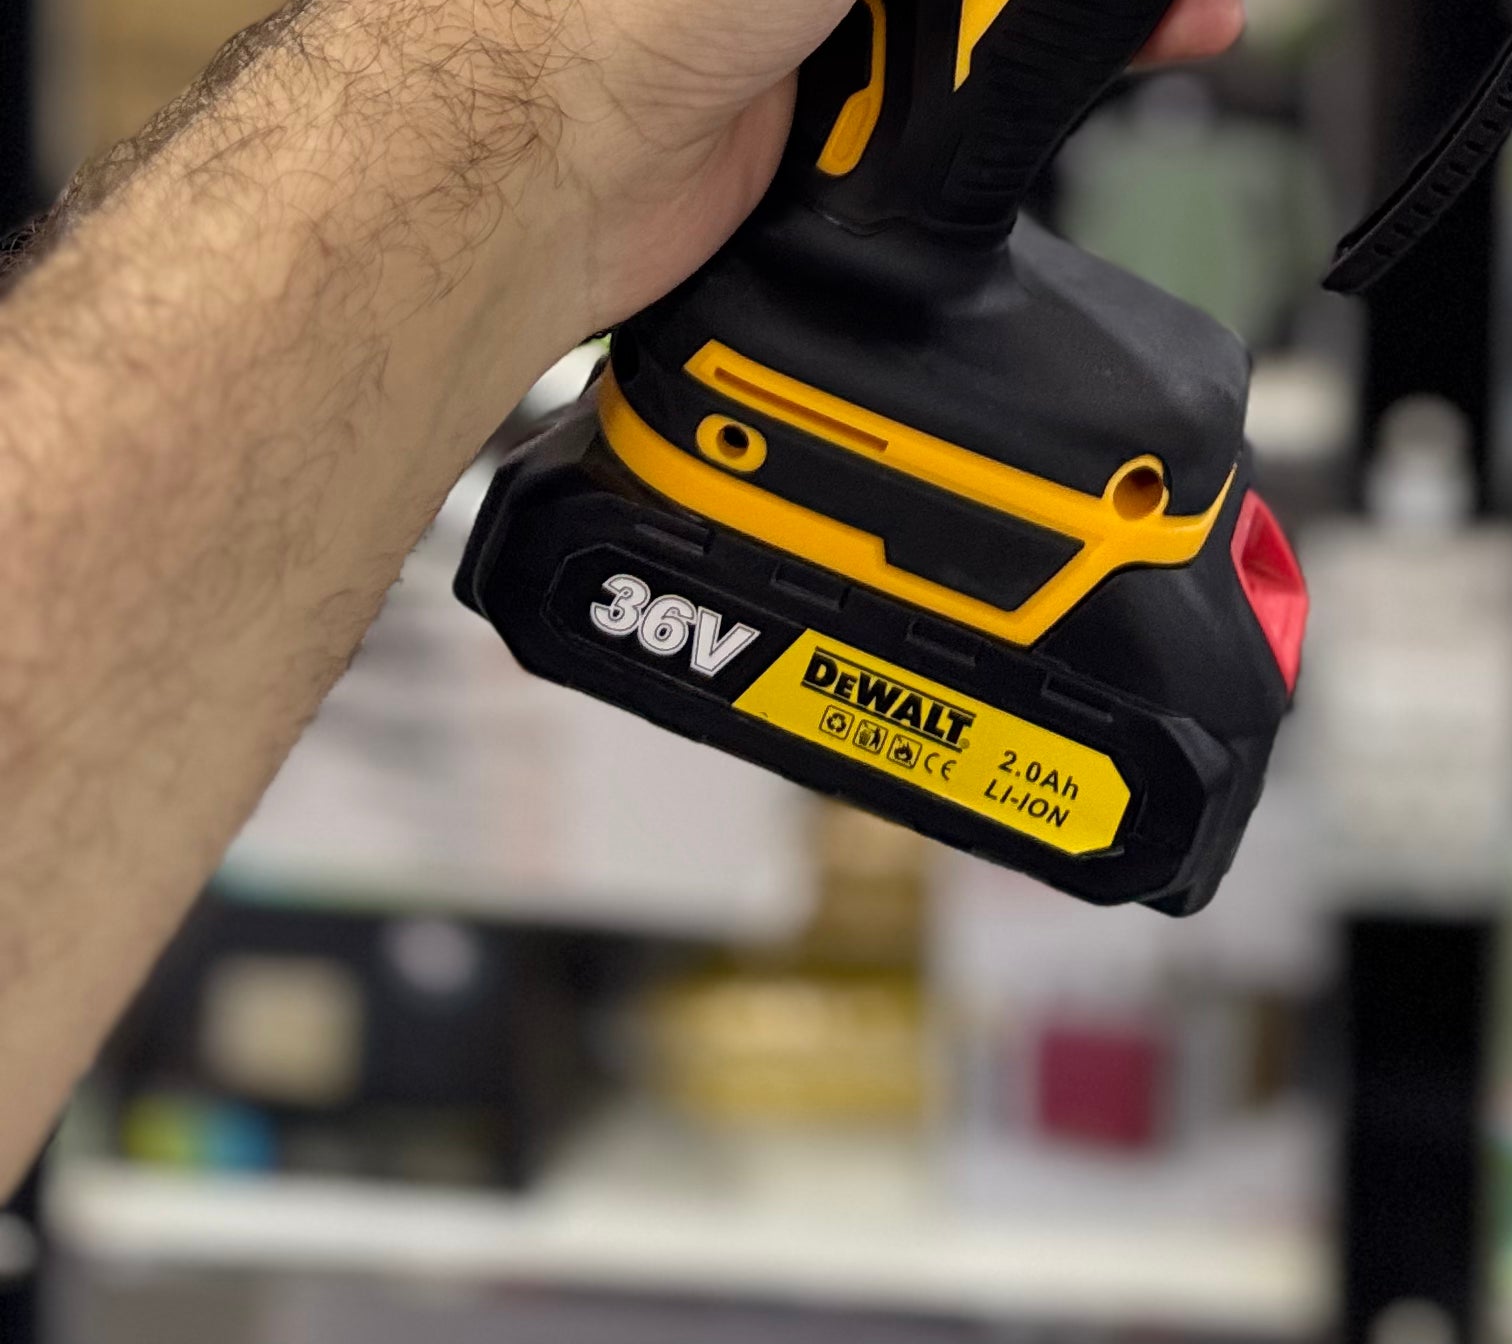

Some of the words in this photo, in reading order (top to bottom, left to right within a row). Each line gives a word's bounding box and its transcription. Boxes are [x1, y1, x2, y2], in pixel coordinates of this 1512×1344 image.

[590, 573, 761, 677] 36V
[998, 750, 1079, 801] 2.0Ah
[984, 778, 1070, 828] LI-ION
